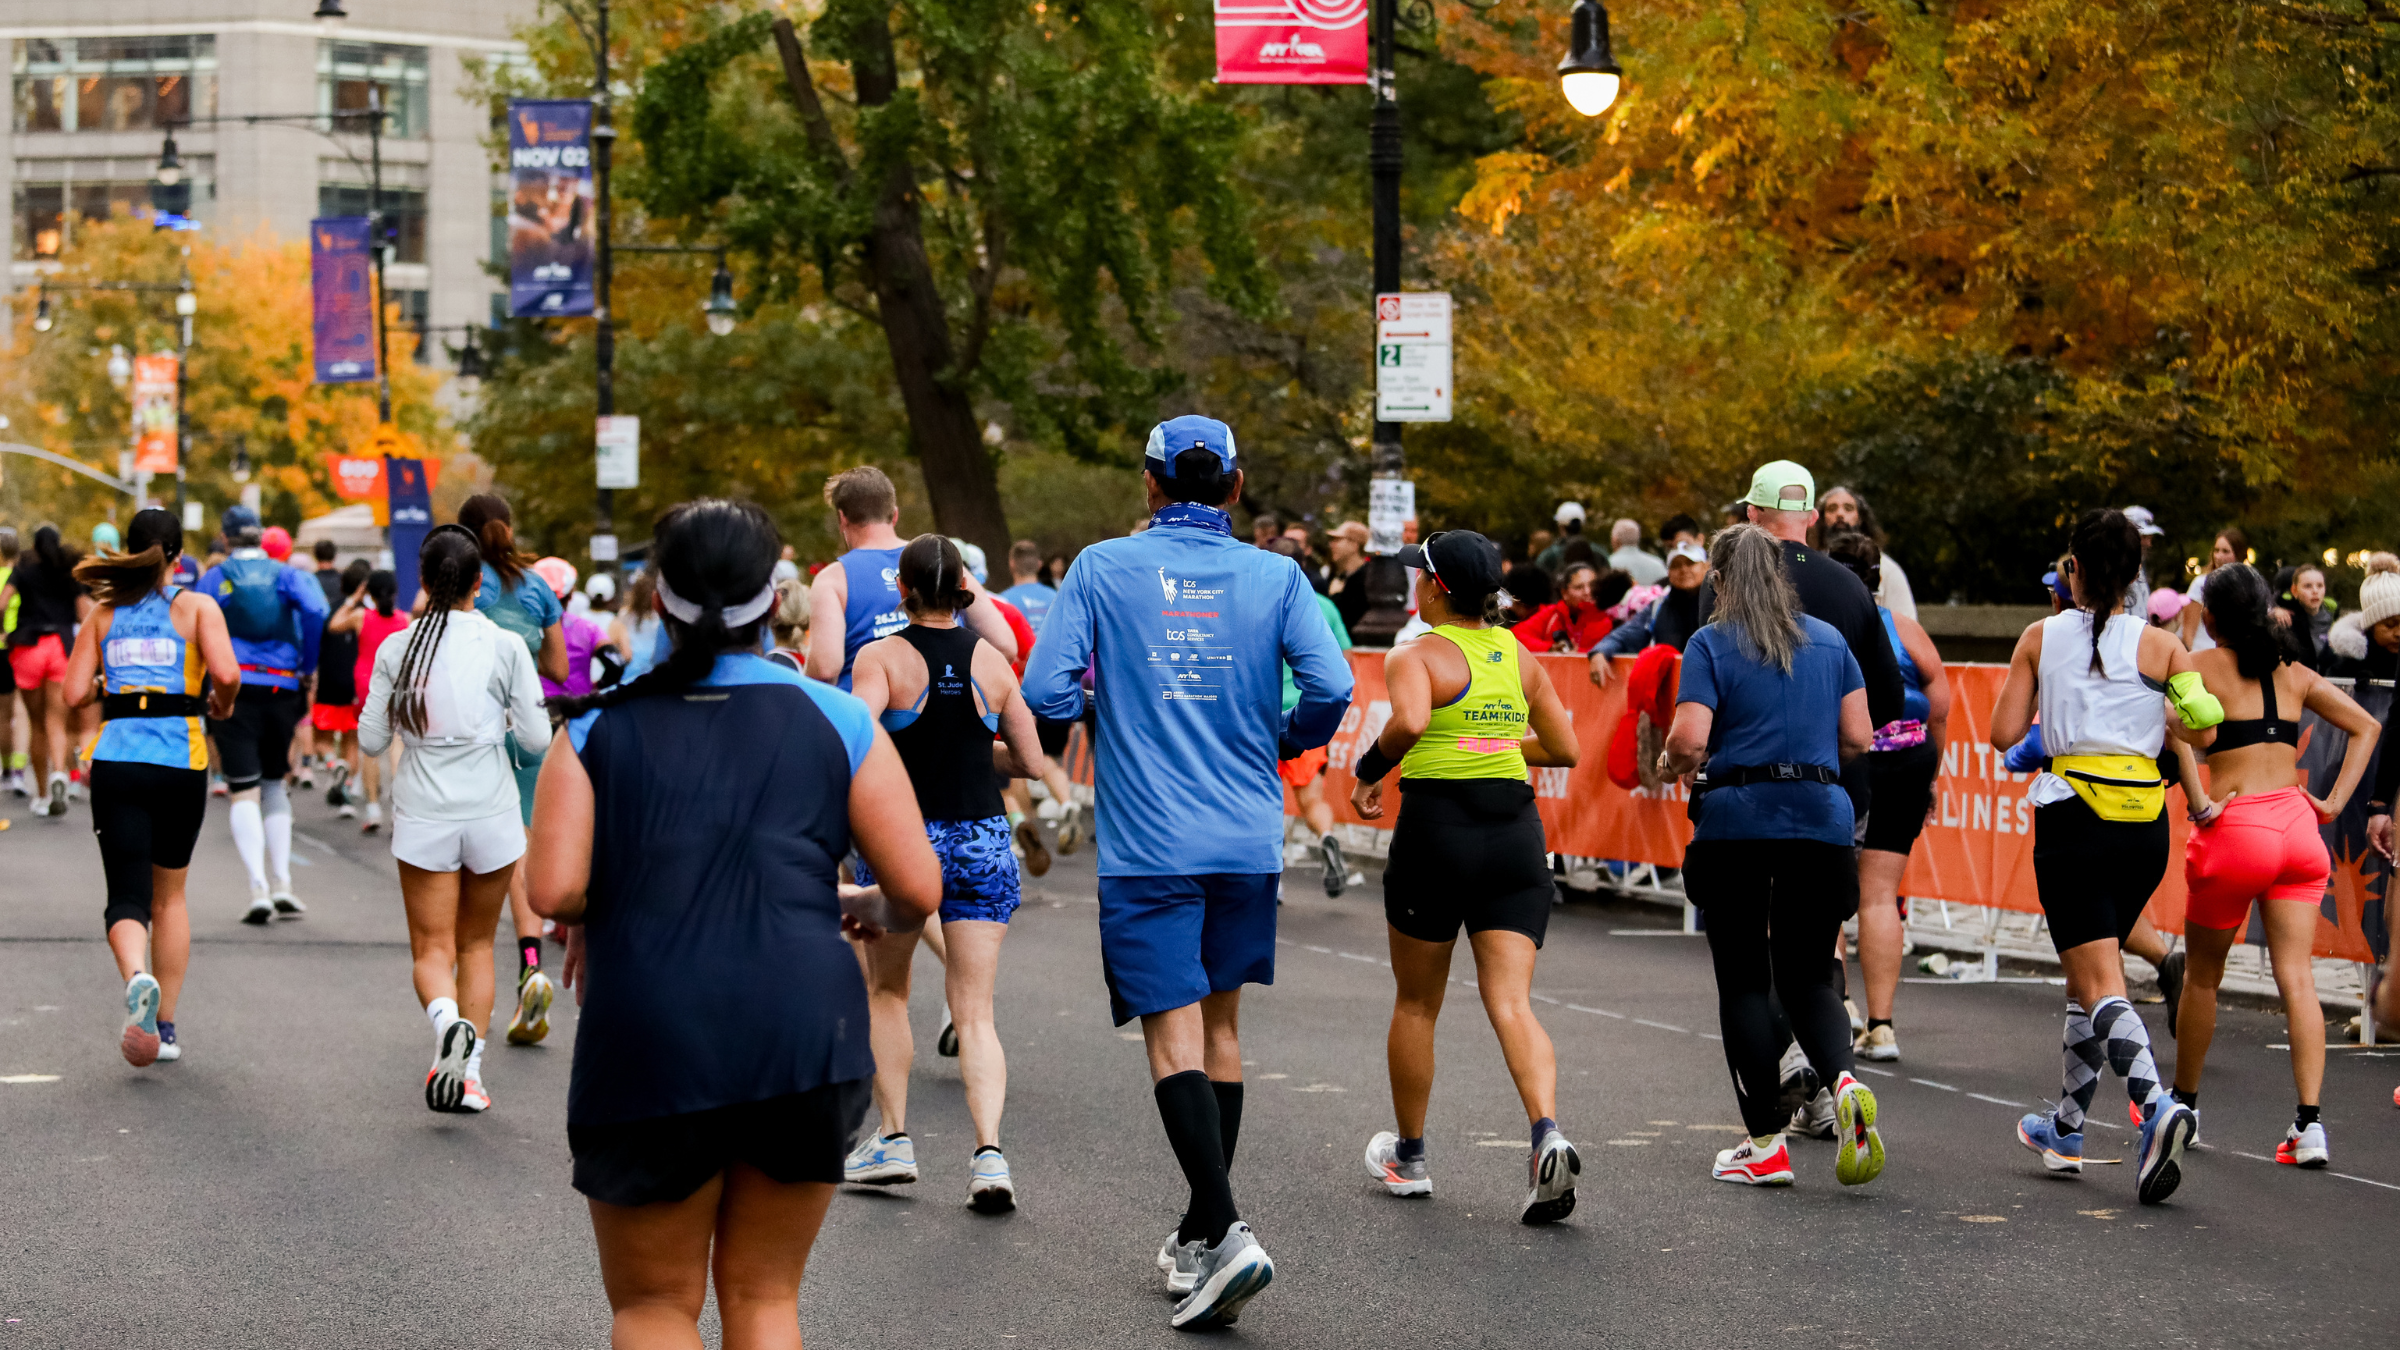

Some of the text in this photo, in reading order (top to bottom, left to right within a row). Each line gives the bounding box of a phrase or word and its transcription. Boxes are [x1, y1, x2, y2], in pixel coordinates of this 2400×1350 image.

[513, 147, 590, 167] NOV 02
[1384, 346, 1397, 367] 2
[1183, 579, 1196, 588] tcs
[875, 612, 899, 626] 26.2
[1162, 610, 1219, 618] MARATHONER
[1166, 629, 1185, 641] tcs
[1463, 711, 1498, 721] TEAM
[1504, 711, 1525, 722] KIDS
[1939, 741, 2028, 783] NITE
[1931, 790, 2030, 835] LINES
[1730, 1147, 1752, 1162] HOKA
